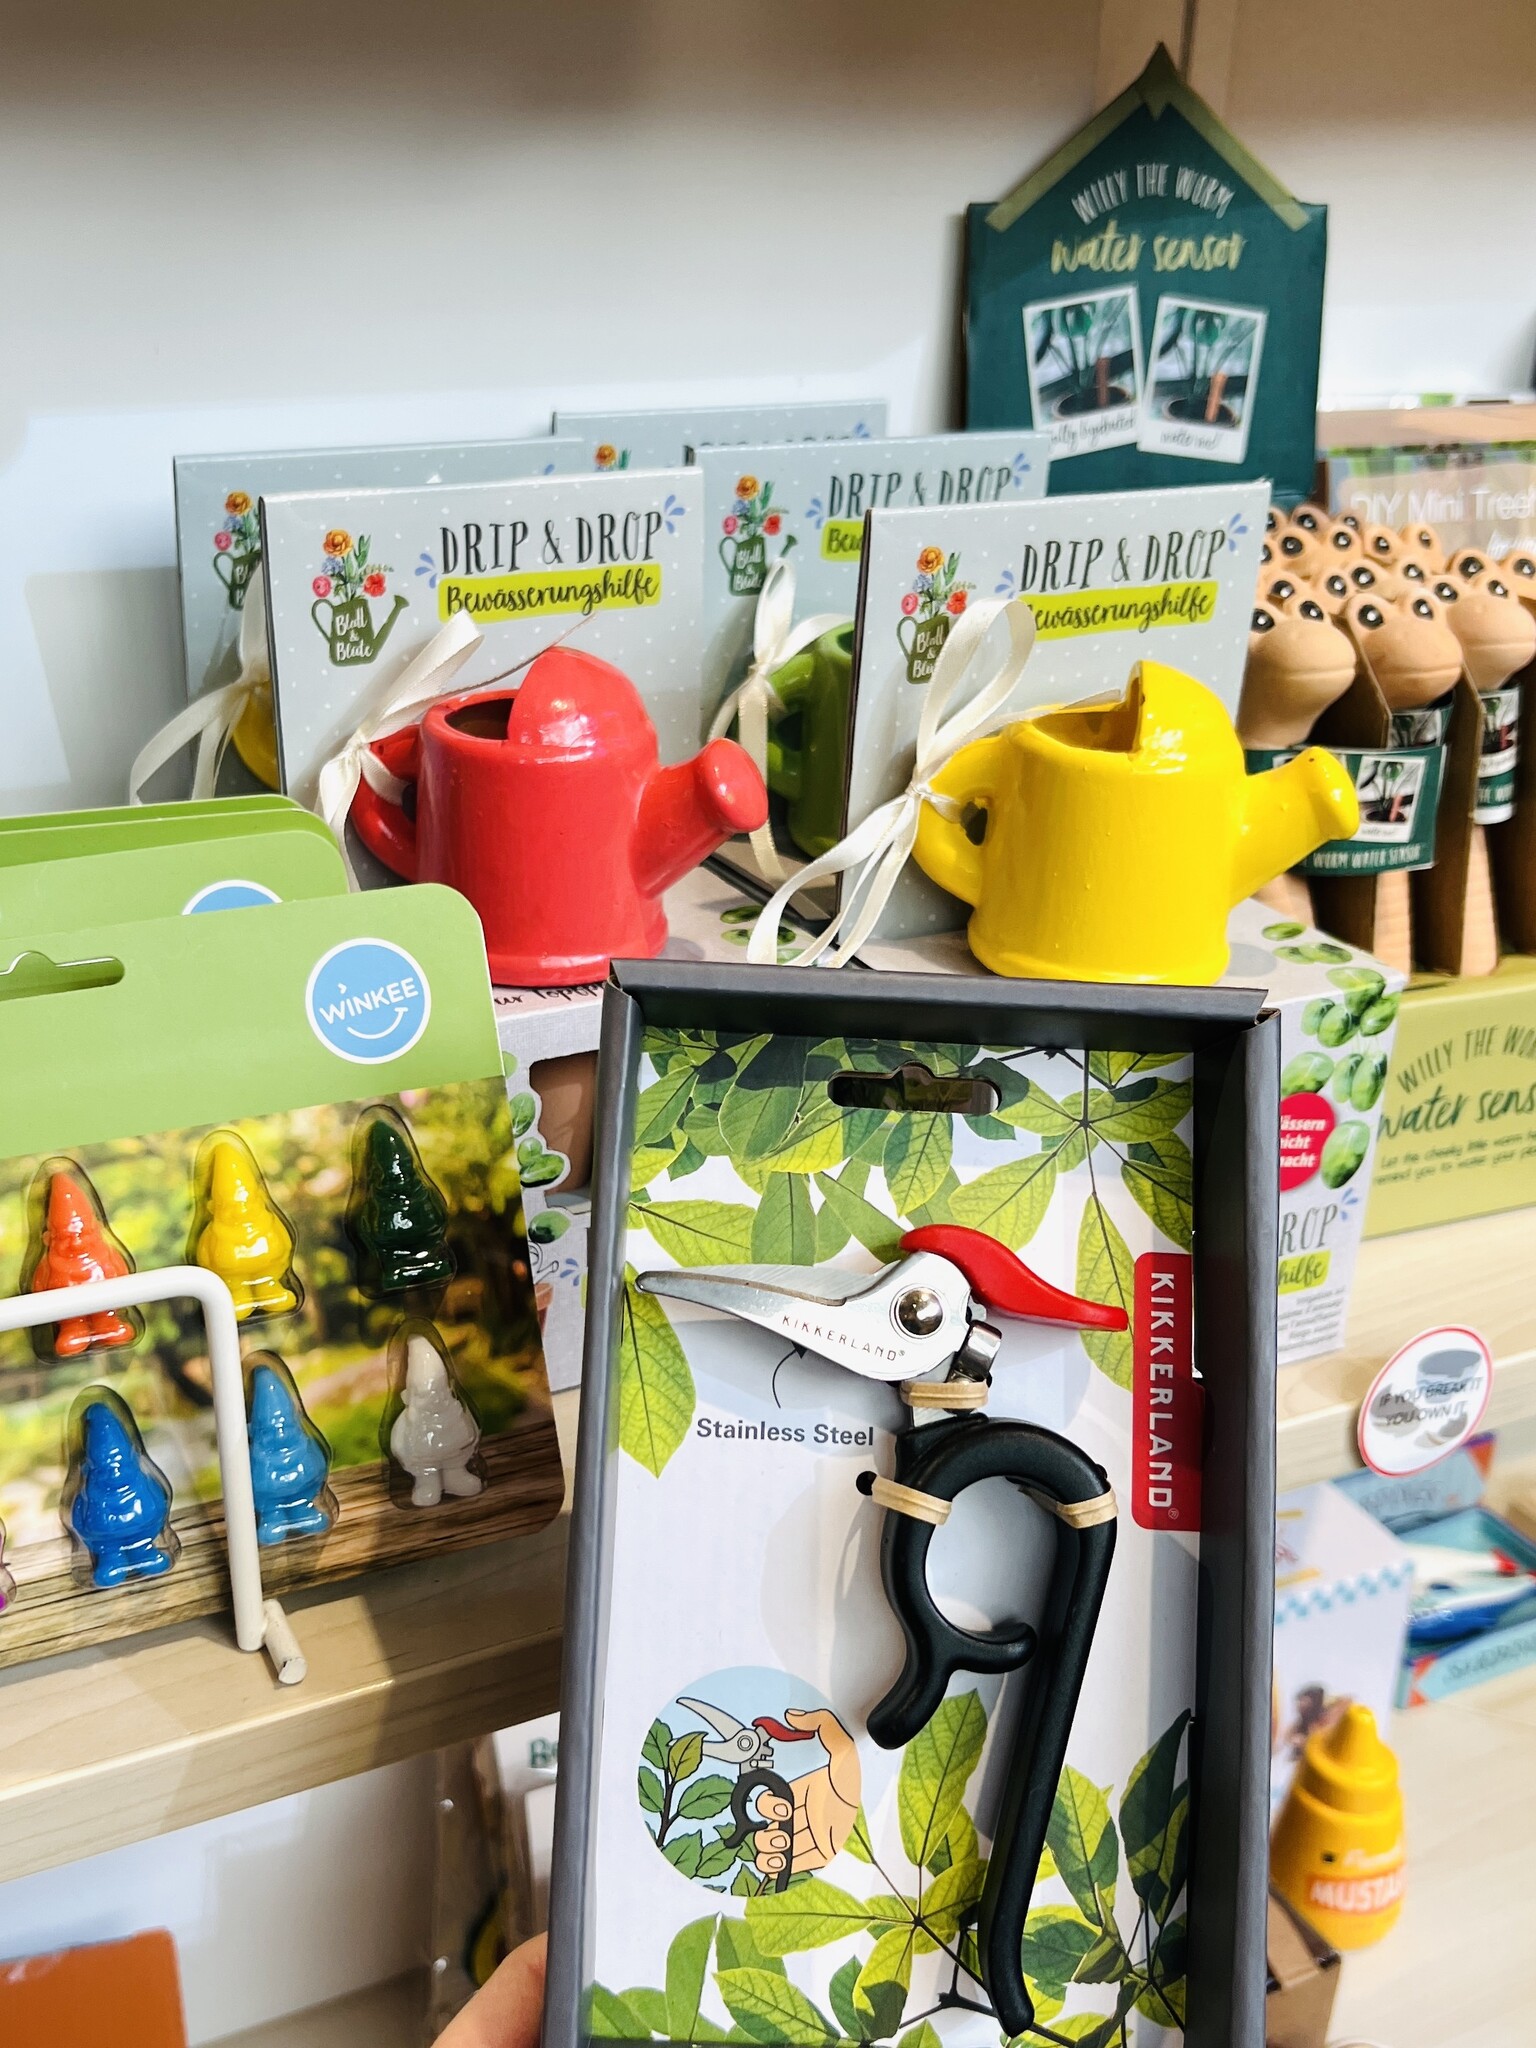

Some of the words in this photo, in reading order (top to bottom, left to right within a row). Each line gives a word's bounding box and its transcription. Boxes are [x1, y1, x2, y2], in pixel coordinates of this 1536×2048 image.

[1071, 168, 1128, 226] WILLY
[1136, 162, 1170, 199] THE
[1174, 165, 1236, 220] WORM
[1051, 218, 1147, 275] water
[1153, 230, 1249, 273] sensor
[829, 472, 902, 518] DRIP
[938, 466, 1012, 505] DROP
[440, 520, 528, 576] DRIP
[542, 519, 563, 565] &
[576, 511, 662, 564] DROP
[1019, 538, 1104, 593] DRIP
[1111, 537, 1131, 583] &
[1142, 529, 1226, 582] DROP
[1029, 586, 1213, 633] ewässerungshilfe
[319, 977, 419, 1025] WINKEE
[1397, 1040, 1453, 1093] WILLY
[1465, 1025, 1497, 1061] THE
[1377, 1085, 1468, 1142] water
[1475, 1081, 1536, 1123] sens
[1279, 1203, 1338, 1257] ROP
[697, 1418, 805, 1443] Stainless
[813, 1424, 874, 1446] Steel
